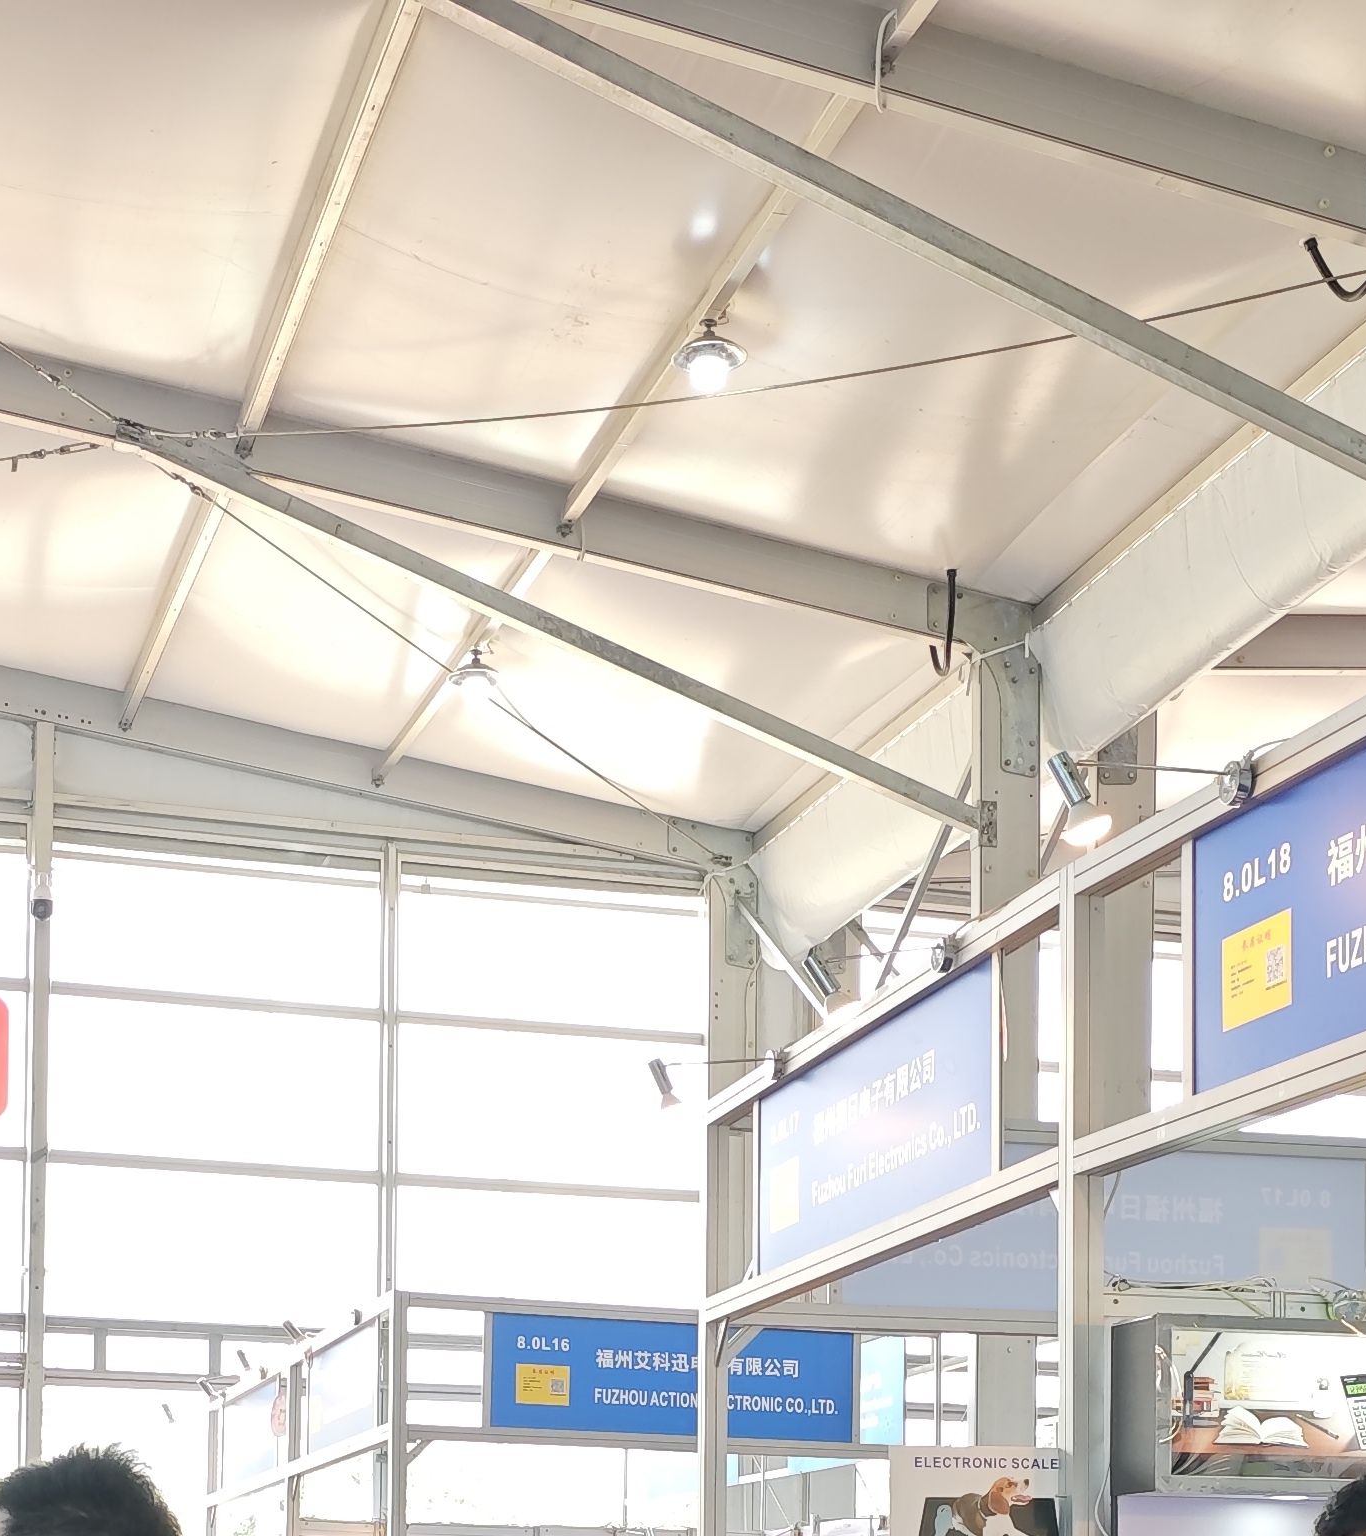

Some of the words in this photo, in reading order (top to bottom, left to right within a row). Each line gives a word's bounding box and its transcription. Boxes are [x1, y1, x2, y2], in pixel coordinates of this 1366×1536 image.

[1222, 840, 1292, 902] 8.0L18
[811, 1174, 847, 1208] Fuzhou
[868, 1132, 927, 1181] Electronics
[953, 1102, 981, 1140] LTD.
[516, 1335, 570, 1352] 8.0L16
[595, 1348, 800, 1379] 福州艾科迅有限公司
[594, 1387, 648, 1407] FUZHOU
[650, 1389, 698, 1409] ACTION
[726, 1394, 783, 1414] CTRONIC
[785, 1397, 839, 1417] CO.,LTD.
[914, 1456, 1008, 1470] ELECTRONIC
[1011, 1457, 1060, 1471] SCALE
